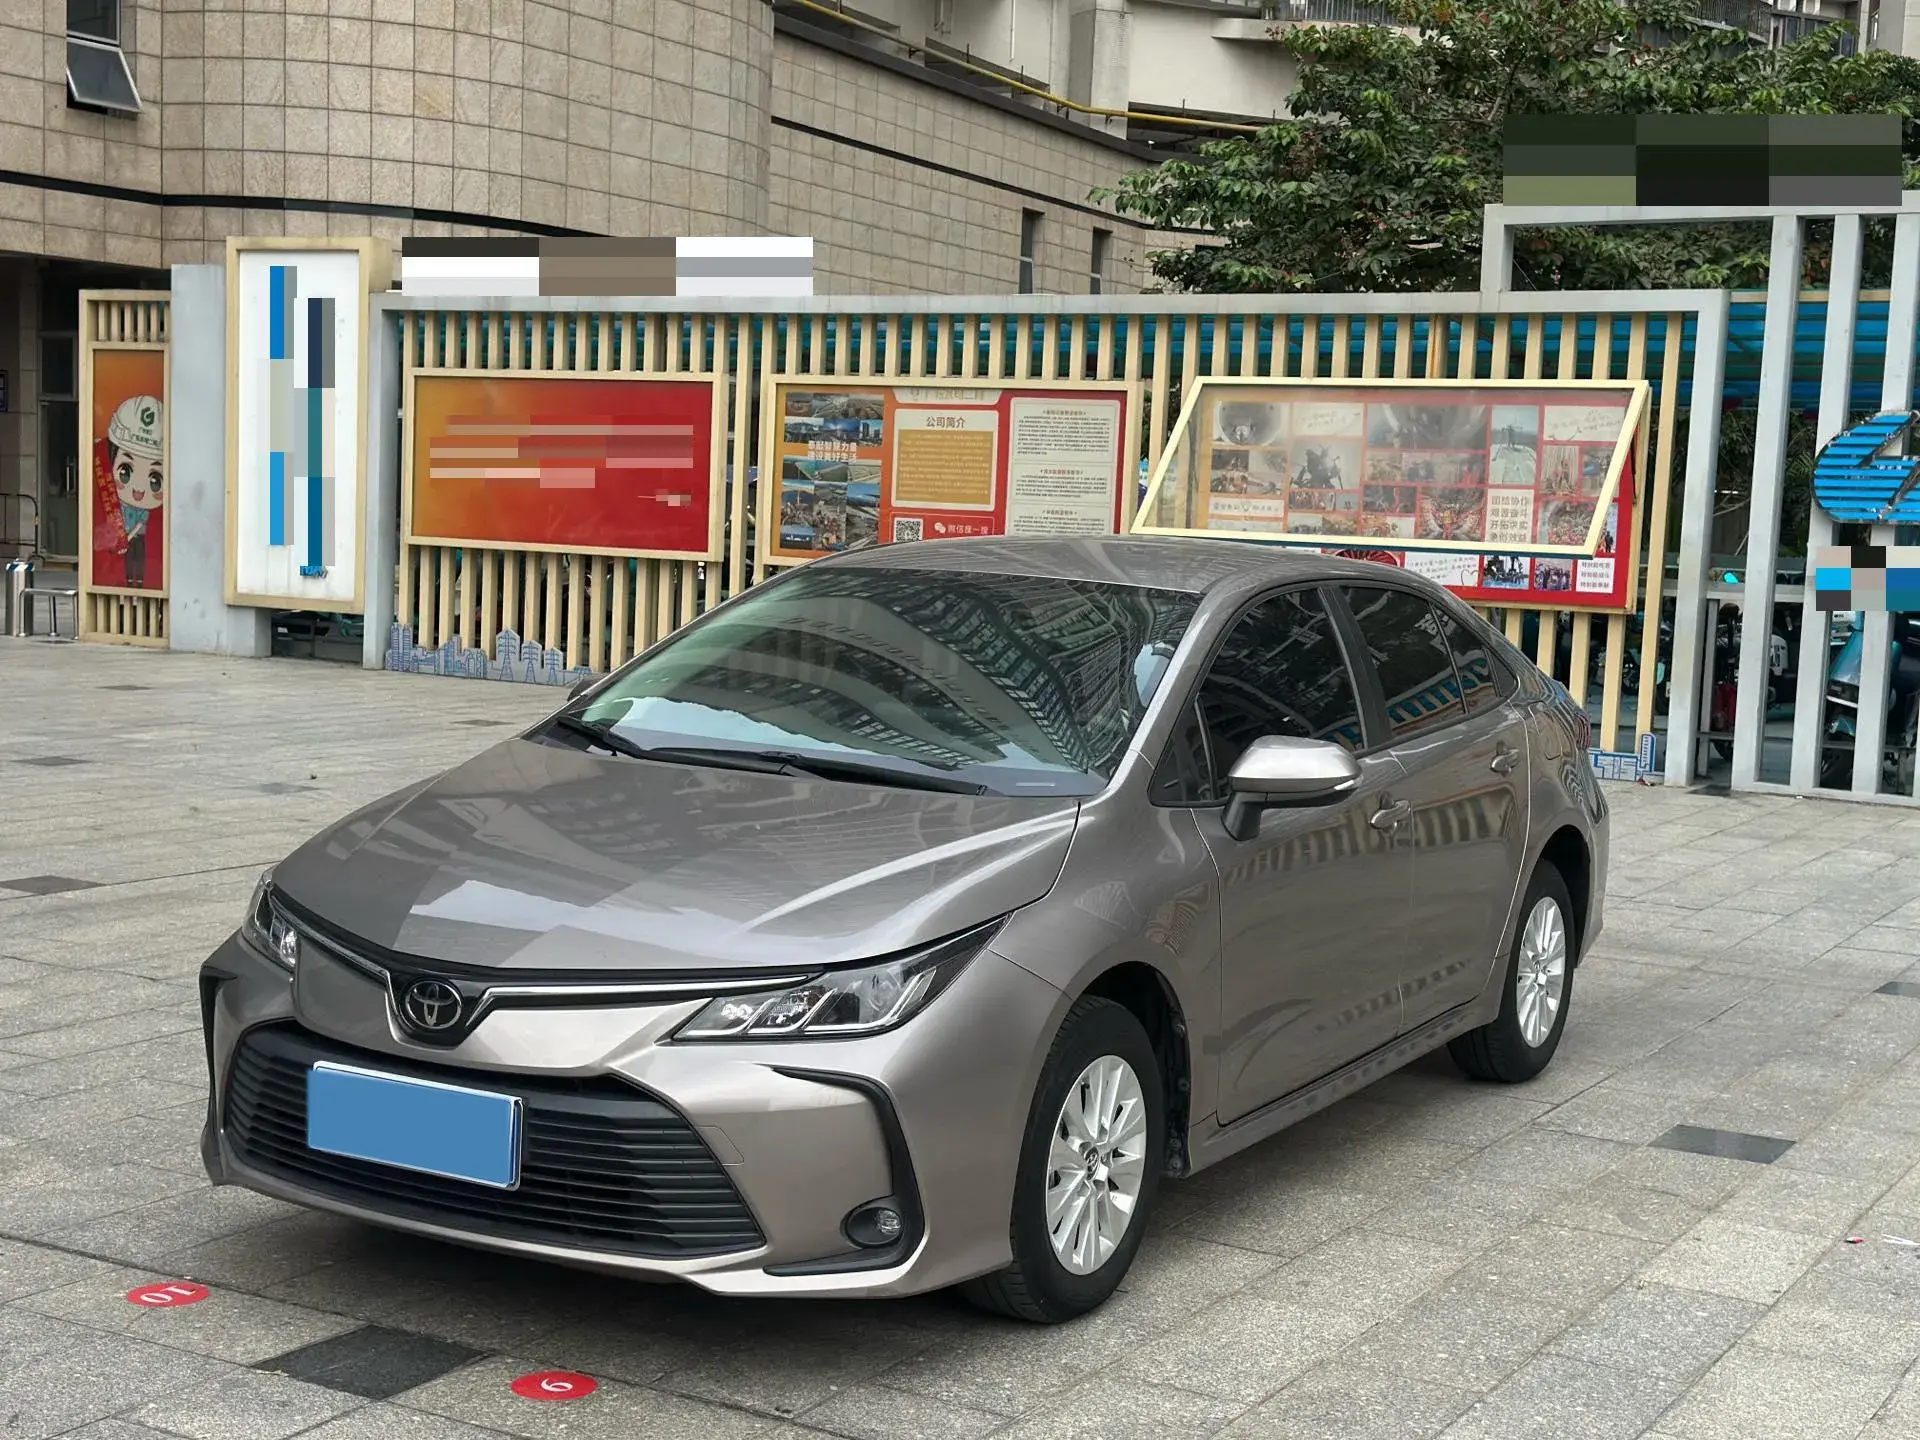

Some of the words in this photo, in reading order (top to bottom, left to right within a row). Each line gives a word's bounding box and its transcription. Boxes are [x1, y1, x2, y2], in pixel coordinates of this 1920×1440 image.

[926, 416, 966, 428] 公司简介
[807, 451, 857, 463] 建设美好生活
[947, 524, 989, 535] 微信搜一搜
[139, 1285, 197, 1303] 10
